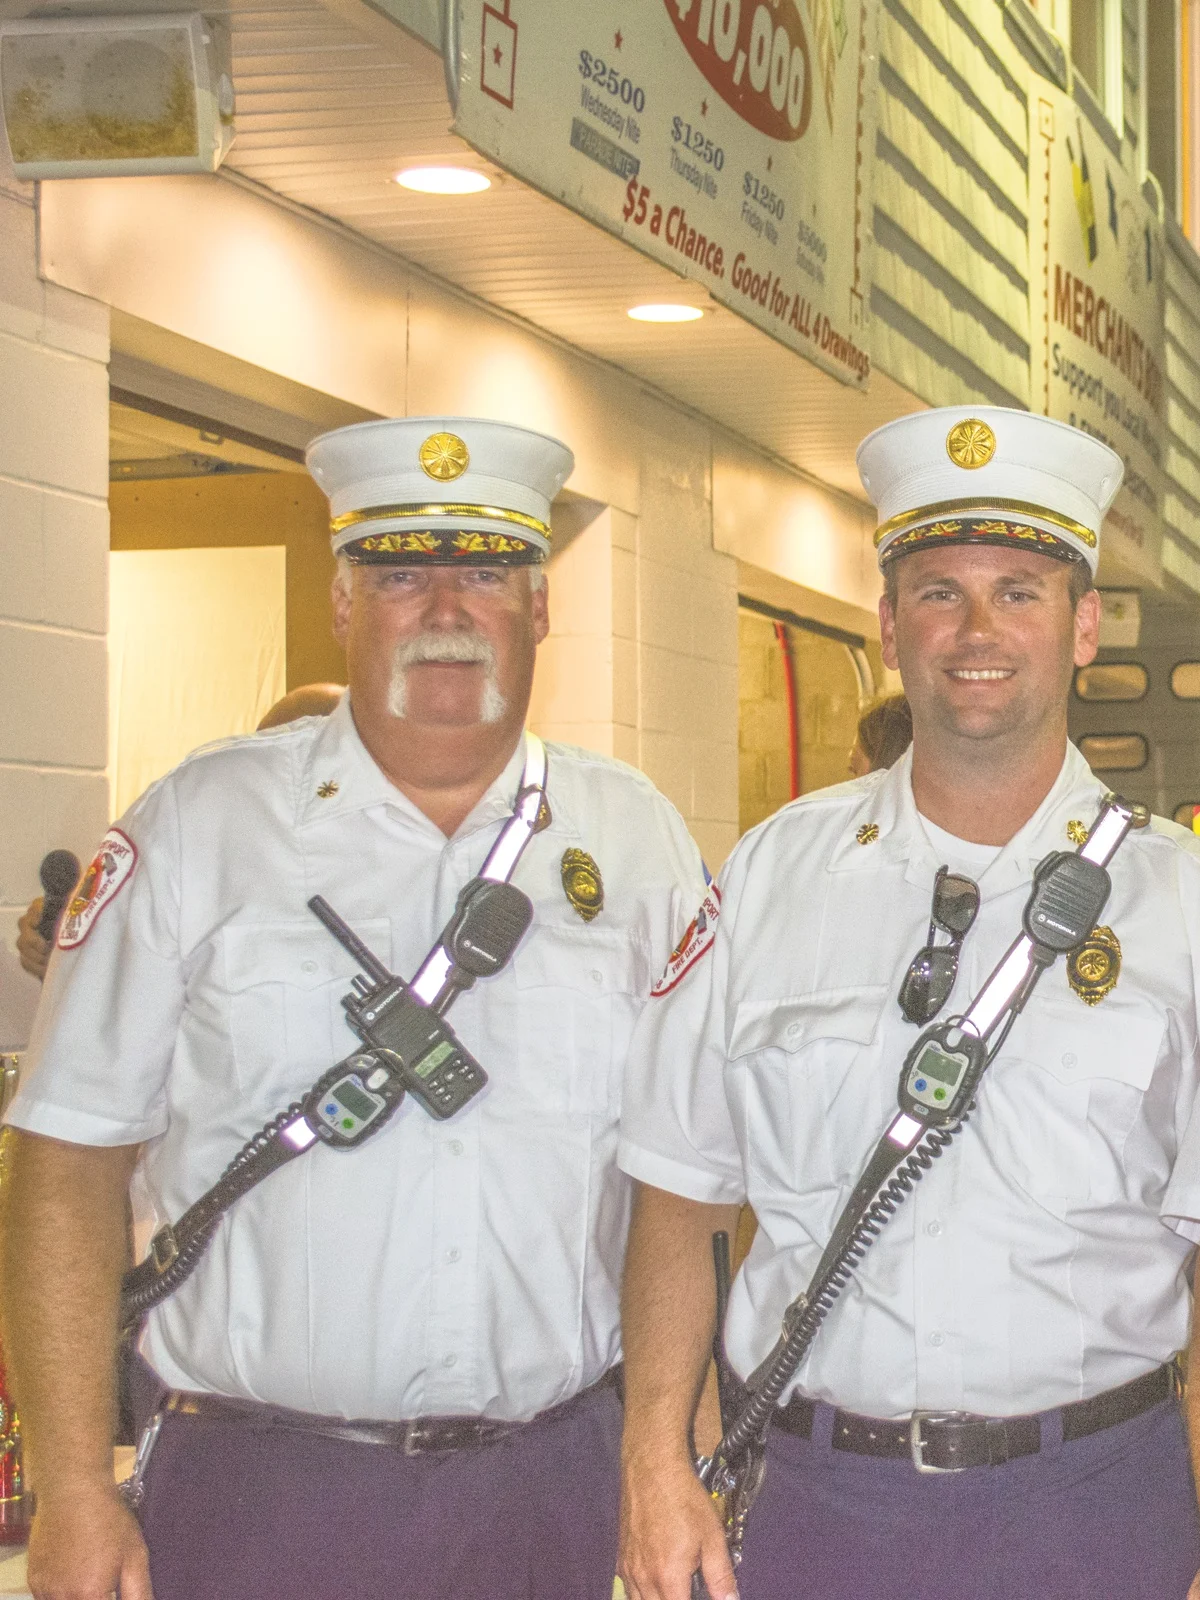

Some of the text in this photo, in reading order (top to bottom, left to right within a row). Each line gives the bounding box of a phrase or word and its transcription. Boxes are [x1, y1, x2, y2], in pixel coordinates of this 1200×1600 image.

[579, 50, 645, 113] $2500
[675, 0, 806, 129] 10,000
[581, 84, 641, 144] Wednesday Nite
[671, 116, 724, 171] $1250
[671, 146, 702, 194] Thursday
[741, 201, 763, 238] Friday
[743, 171, 785, 220] $1250
[623, 176, 650, 225] $5
[650, 204, 662, 236] a
[665, 206, 725, 279] Chance.
[731, 251, 772, 307] Good
[769, 276, 790, 320] for
[788, 293, 811, 339] ALL
[812, 311, 821, 344] 4
[821, 316, 870, 382] Drawings
[1053, 342, 1103, 408] Support
[84, 898, 98, 919] FIRE
[1046, 919, 1076, 936] MOTOROLA
[471, 945, 497, 963] MOTOROLA
[672, 937, 703, 974] FIRE DEPT.
[374, 986, 404, 1013] MOTOROLA
